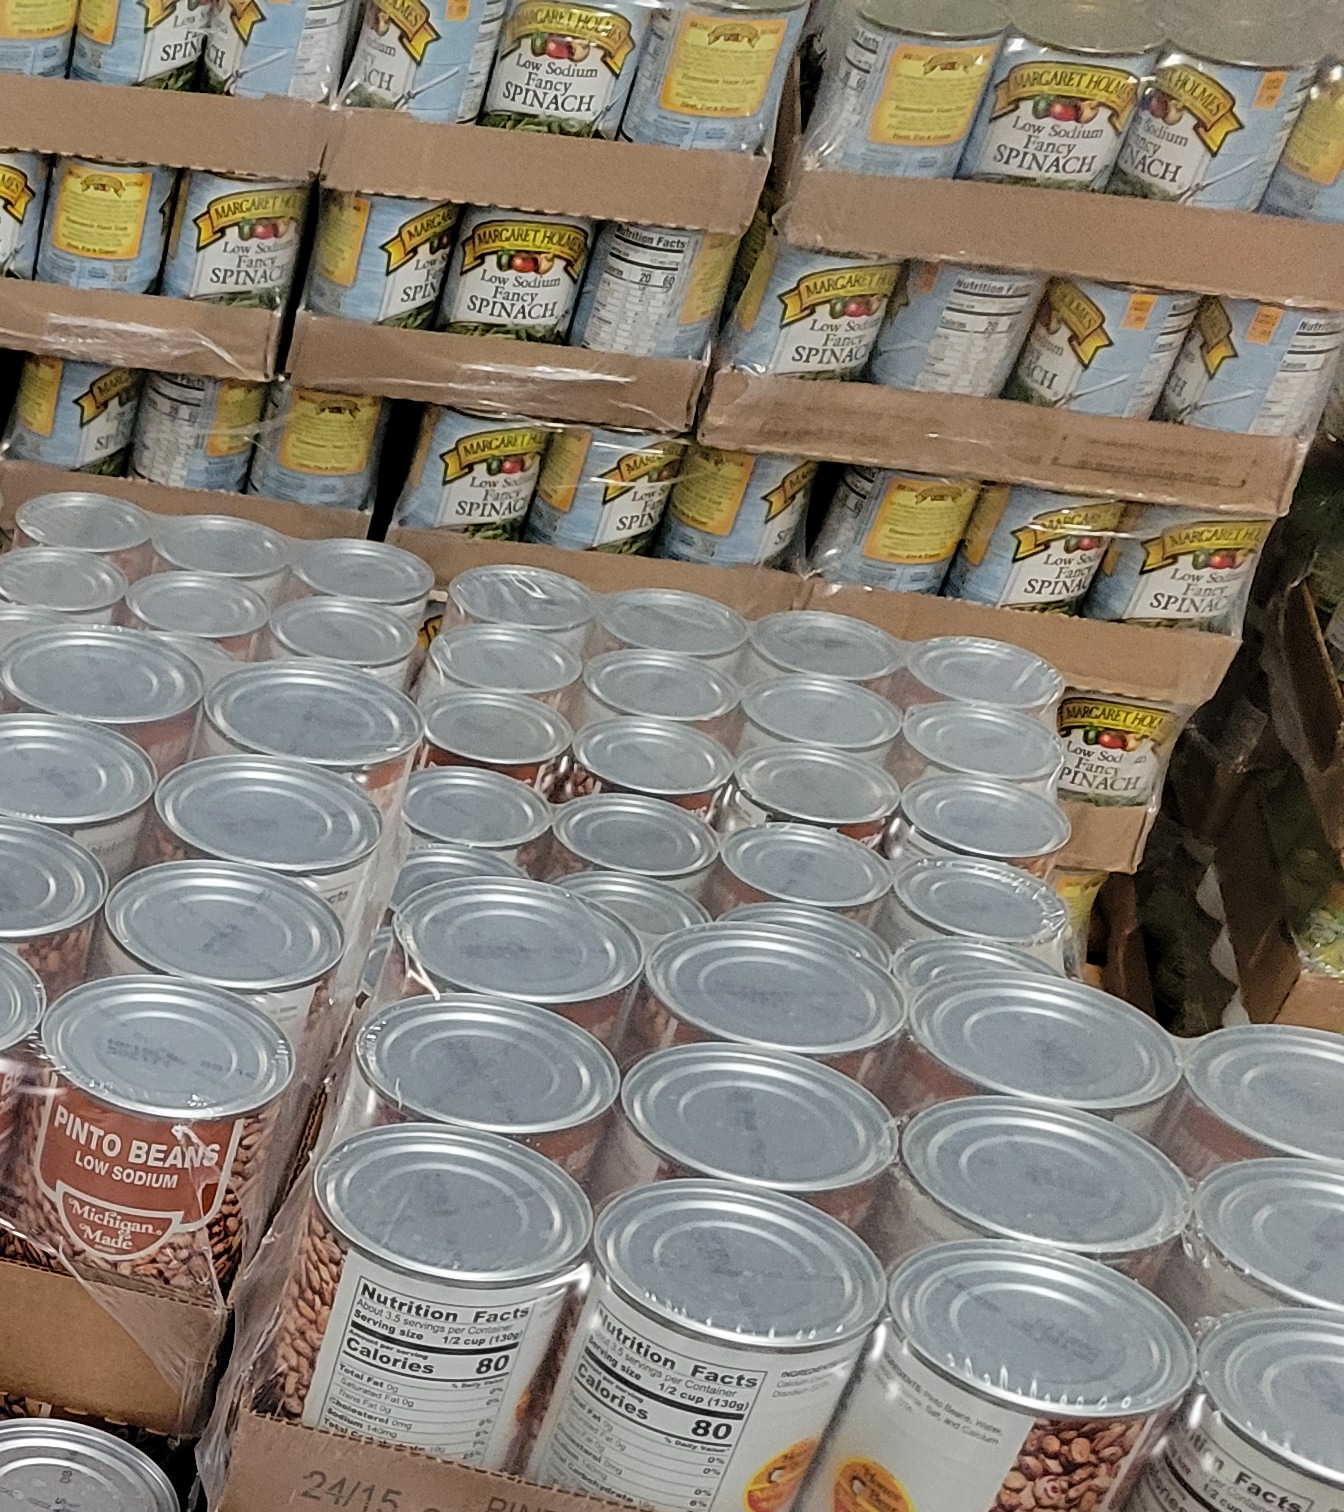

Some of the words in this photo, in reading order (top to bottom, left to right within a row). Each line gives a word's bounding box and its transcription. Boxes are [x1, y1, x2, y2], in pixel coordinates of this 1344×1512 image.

[515, 53, 544, 71] Low
[546, 61, 598, 78] Sodium
[525, 72, 572, 96] Fancy
[1087, 72, 1139, 101] HOLMES
[1178, 69, 1228, 118] HOLMES
[503, 82, 595, 113] SPINACH
[1012, 116, 1044, 133] Low
[1048, 124, 1104, 140] Sodium
[1023, 134, 1077, 158] Fancy
[993, 144, 1097, 174] SPINACH
[214, 197, 276, 219] MARGARET
[223, 240, 252, 255] Low
[477, 227, 539, 249] MARGARET
[656, 235, 686, 249] Facts
[480, 269, 509, 287] Low
[512, 275, 561, 288] Sodium
[638, 271, 652, 284] 20
[662, 274, 675, 287] 60
[805, 272, 875, 298] MARGARET
[955, 277, 1006, 294] Nutrition
[467, 295, 558, 320] SPINACH
[492, 285, 539, 306] Fancy
[810, 319, 842, 332] Low
[462, 431, 526, 456] MARGARET
[470, 476, 500, 488] Low
[1169, 529, 1239, 547] MARGARET
[1044, 554, 1075, 566] Low
[1066, 705, 1130, 726] MARGARET
[1067, 740, 1095, 757] Low
[53, 1105, 123, 1155] PINTO
[128, 1138, 221, 1169] BEANS
[74, 1149, 108, 1174] LOW
[110, 1160, 179, 1190] SODIUM
[66, 1194, 155, 1237] Michigan
[81, 1223, 133, 1250] Made
[360, 1283, 459, 1323] Nutrition
[472, 1306, 530, 1324] Facts
[353, 1310, 396, 1335] Serving
[403, 1318, 445, 1334] servings
[346, 1336, 435, 1375] Calories
[475, 1354, 510, 1375] 80
[625, 1353, 662, 1378] servings
[684, 1380, 737, 1398] Container
[690, 1364, 758, 1388] Facts
[578, 1363, 649, 1420] Calories
[691, 1419, 733, 1440] 80
[327, 1408, 363, 1429] Sodium
